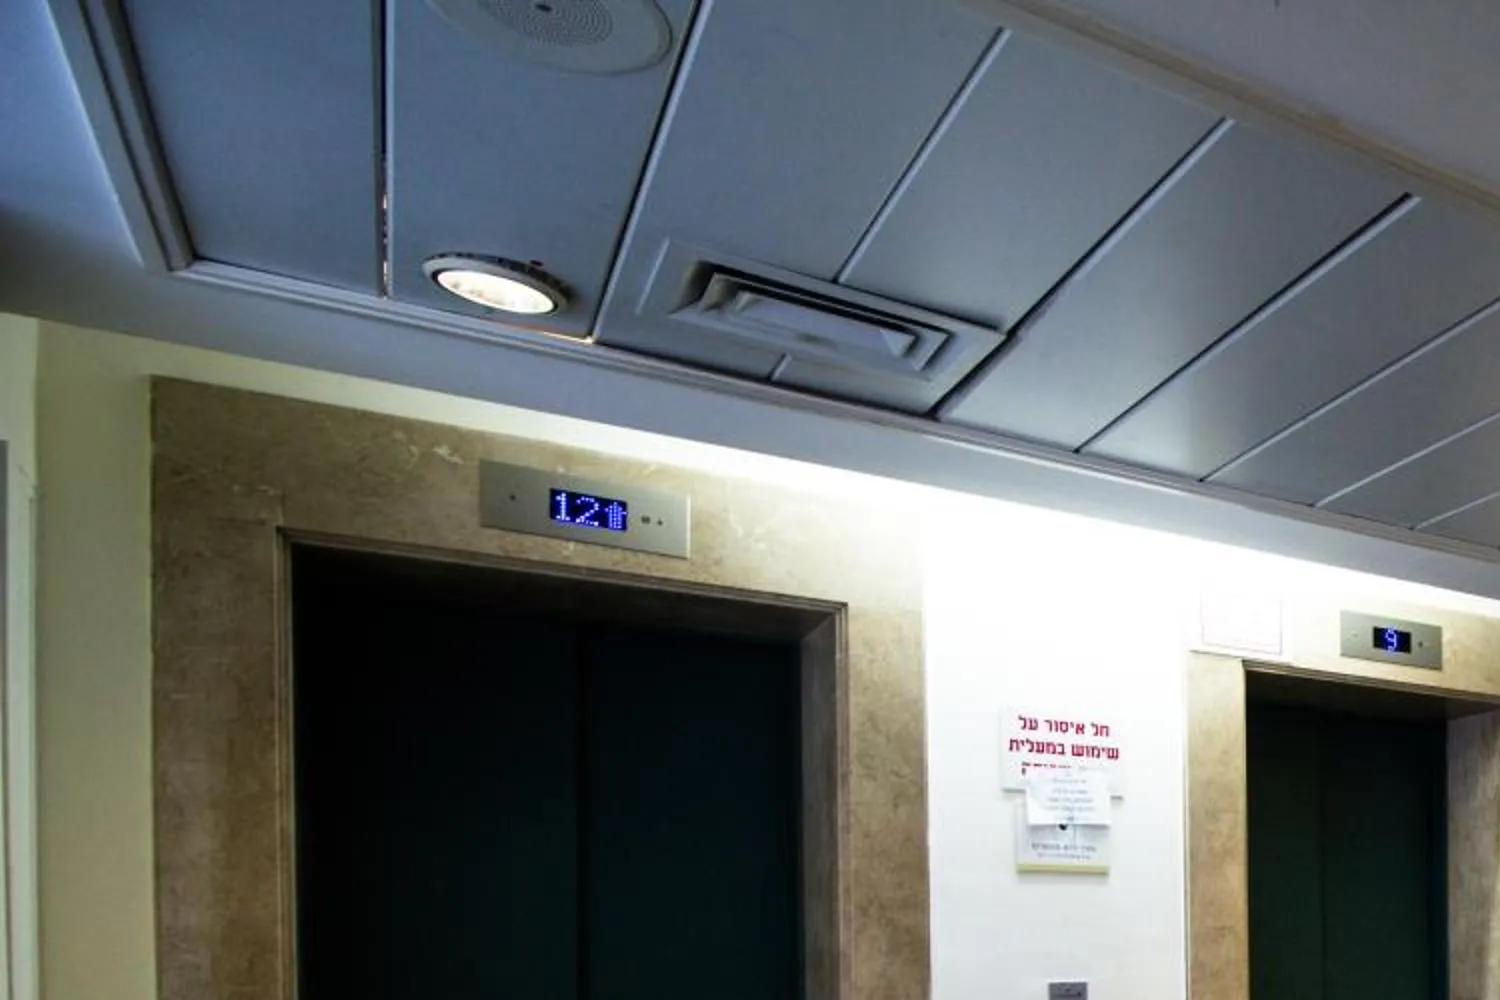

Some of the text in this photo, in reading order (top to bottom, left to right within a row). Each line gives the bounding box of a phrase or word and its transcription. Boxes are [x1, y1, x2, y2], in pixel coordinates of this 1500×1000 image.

[555, 492, 599, 527] 12
[1385, 627, 1398, 652] 9
[1018, 715, 1110, 737] חל איסור על
[1008, 737, 1120, 760] שימוש במעלית
